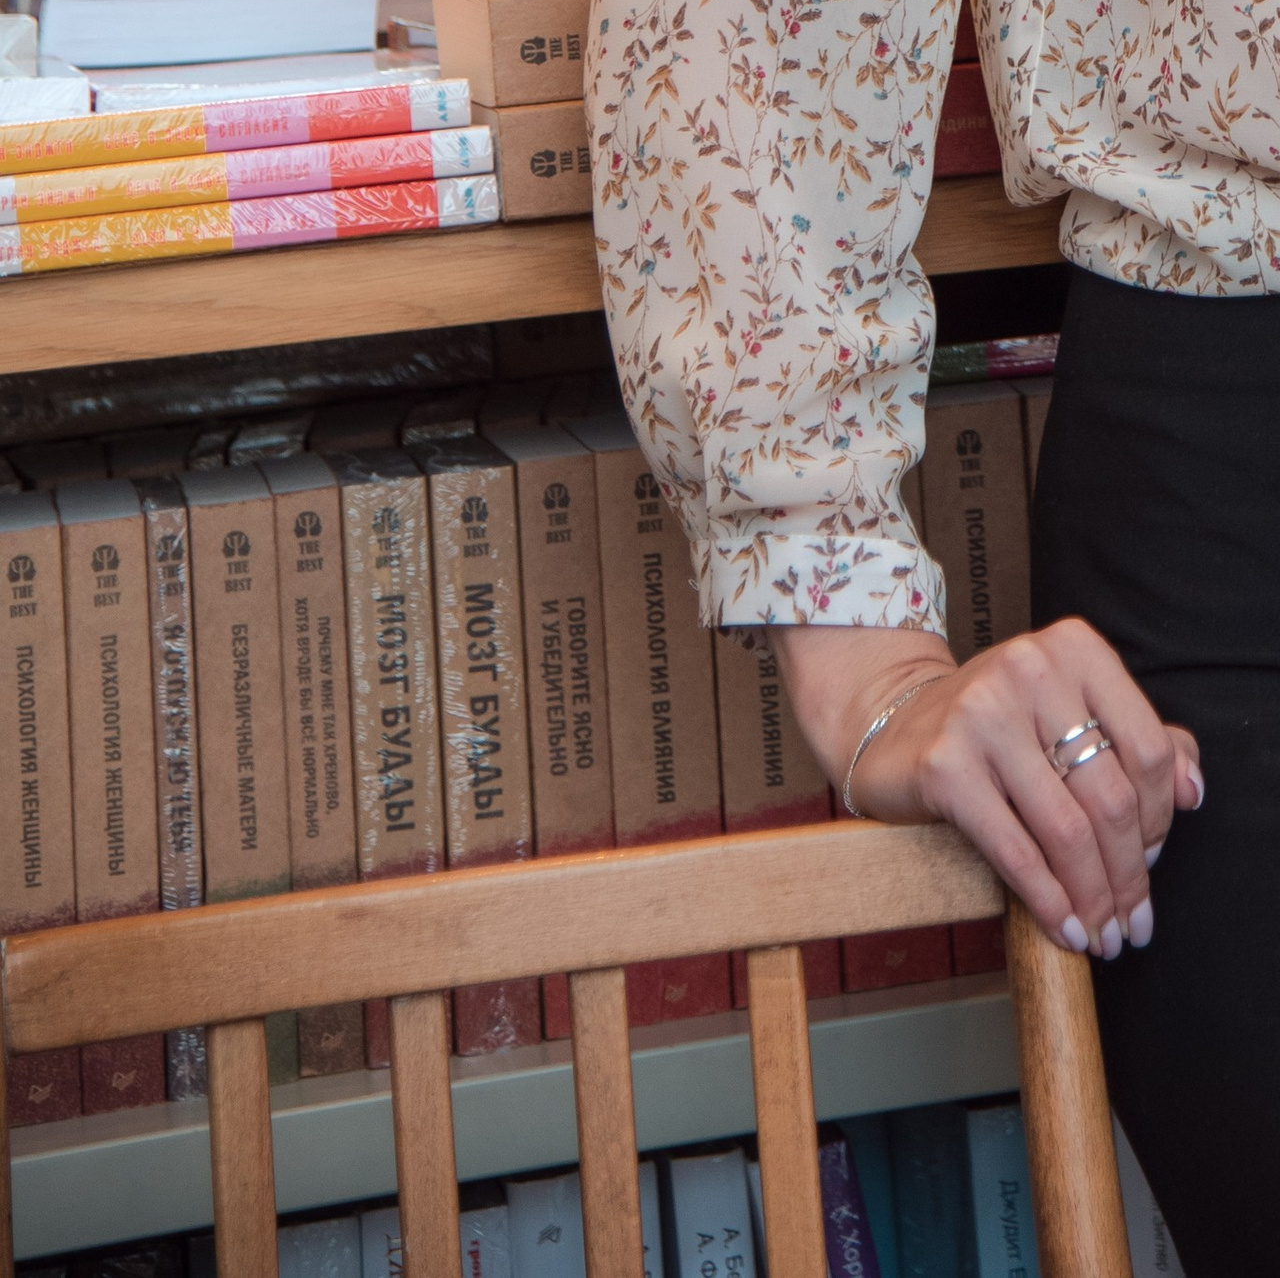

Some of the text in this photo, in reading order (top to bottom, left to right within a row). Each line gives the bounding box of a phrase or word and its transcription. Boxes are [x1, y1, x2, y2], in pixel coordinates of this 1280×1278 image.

[551, 36, 563, 60] THE
[567, 33, 581, 62] BEST
[560, 149, 573, 174] THE
[578, 146, 590, 174] BEST
[549, 512, 568, 526] THE
[639, 502, 659, 516] THE
[546, 529, 572, 544] BEST
[637, 518, 664, 535] BEST
[300, 541, 320, 555] THE
[463, 542, 490, 558] BEST
[227, 560, 248, 574] THE
[297, 557, 324, 573] BEST
[965, 508, 993, 649] ПСИХОЛОГИЯ
[12, 585, 33, 599] THE
[96, 574, 117, 589] THE
[225, 578, 251, 593] BEST
[10, 603, 37, 618] BEST
[94, 592, 121, 607] BEST
[295, 598, 310, 634] ХОТЯ
[317, 616, 333, 675] ПОЧЕМУ
[296, 637, 311, 684] ВРОДЕ
[541, 599, 568, 777] И УБЕДИТЕЛЬНО
[567, 596, 594, 770] ГОВОРИТЕ ЯСНО
[644, 552, 676, 804] ПСИХОЛОГИЯ ВЛИЯНИЯ
[299, 688, 312, 712] БЫ
[320, 680, 334, 711] МНЕ
[465, 583, 504, 820] МОЗГ БУДДЫ
[375, 594, 415, 832] МОЗГ БУДДЫ
[231, 623, 258, 851] БЕЗРАЗЛИЧНЫЕ МАТЕРИ
[321, 714, 335, 741] ТАК
[760, 684, 784, 788] ВЛИЯНИЯ
[16, 645, 42, 889] ПСИХОЛОГИЯ ЖЕНЩИНЫ
[100, 634, 126, 877] ПСИХОЛОГИЯ ЖЕНЩИНЫ
[302, 747, 320, 839] НОРМАЛЬНО
[999, 1180, 1022, 1259] Джудит
[839, 1228, 864, 1278] Хор
